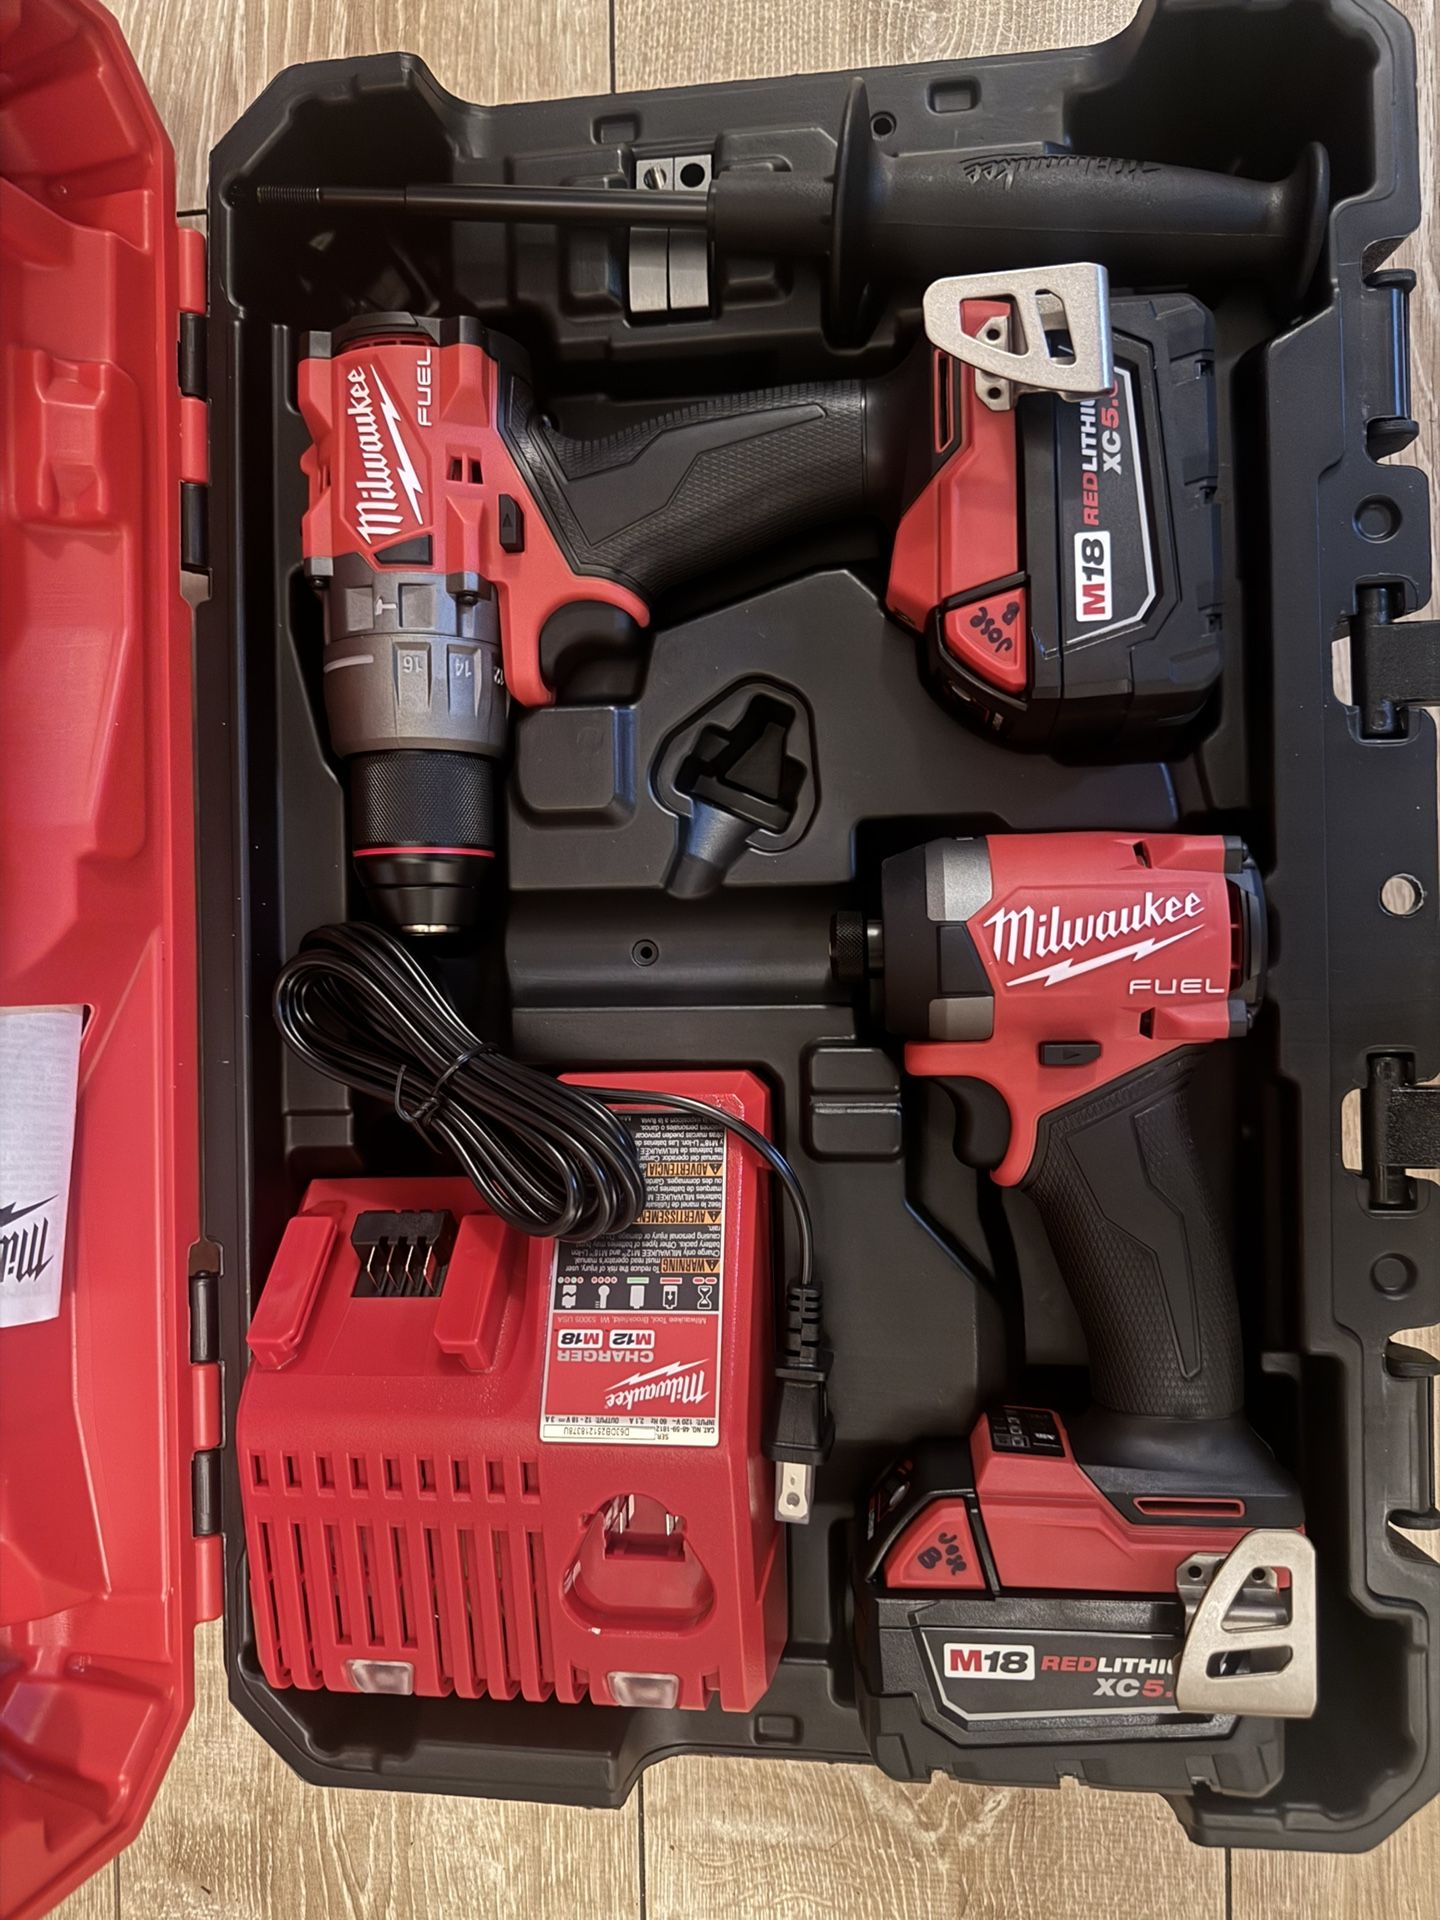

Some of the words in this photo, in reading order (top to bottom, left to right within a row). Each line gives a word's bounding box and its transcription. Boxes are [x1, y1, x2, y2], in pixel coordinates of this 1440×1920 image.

[417, 349, 432, 426] FUEL
[347, 366, 404, 544] Milwaukee
[1082, 538, 1106, 615] M18
[970, 606, 1013, 653] Jose
[403, 656, 422, 673] 16
[455, 658, 471, 678] 14
[983, 892, 1205, 966] Milwaukee
[1129, 978, 1225, 994] FUEL
[666, 1124, 699, 1132] personales
[662, 1131, 684, 1139] pueden
[661, 1153, 689, 1161] operador.
[649, 1163, 708, 1176] ADVERTENCIA
[666, 1176, 701, 1185] dommages.
[695, 1184, 721, 1192] marques
[655, 1193, 695, 1201] MILWAUKEE
[696, 1193, 721, 1201] batteries
[636, 1210, 706, 1223] AVERTISSEMEN
[651, 1232, 668, 1240] injury
[669, 1232, 696, 1240] personal
[697, 1232, 720, 1240] causing
[642, 1240, 658, 1248] types
[678, 1239, 698, 1248] packs.
[699, 1240, 720, 1248] battery
[642, 1249, 682, 1257] MILWAUKEE
[683, 1247, 696, 1257] only
[697, 1248, 720, 1257] Charge
[598, 1256, 629, 1264] operator's
[619, 1265, 629, 1273] the
[630, 1265, 651, 1273] reduce
[652, 1265, 660, 1273] To
[662, 1259, 705, 1272] WARNING
[612, 1315, 649, 1324] Brookfield,
[669, 1316, 707, 1324] Milwaukee
[561, 1332, 600, 1345] M18
[612, 1332, 652, 1345] M12
[557, 1349, 654, 1363] CHARGER
[605, 1370, 710, 1410] Milwaukee
[950, 1649, 1028, 1674] M18
